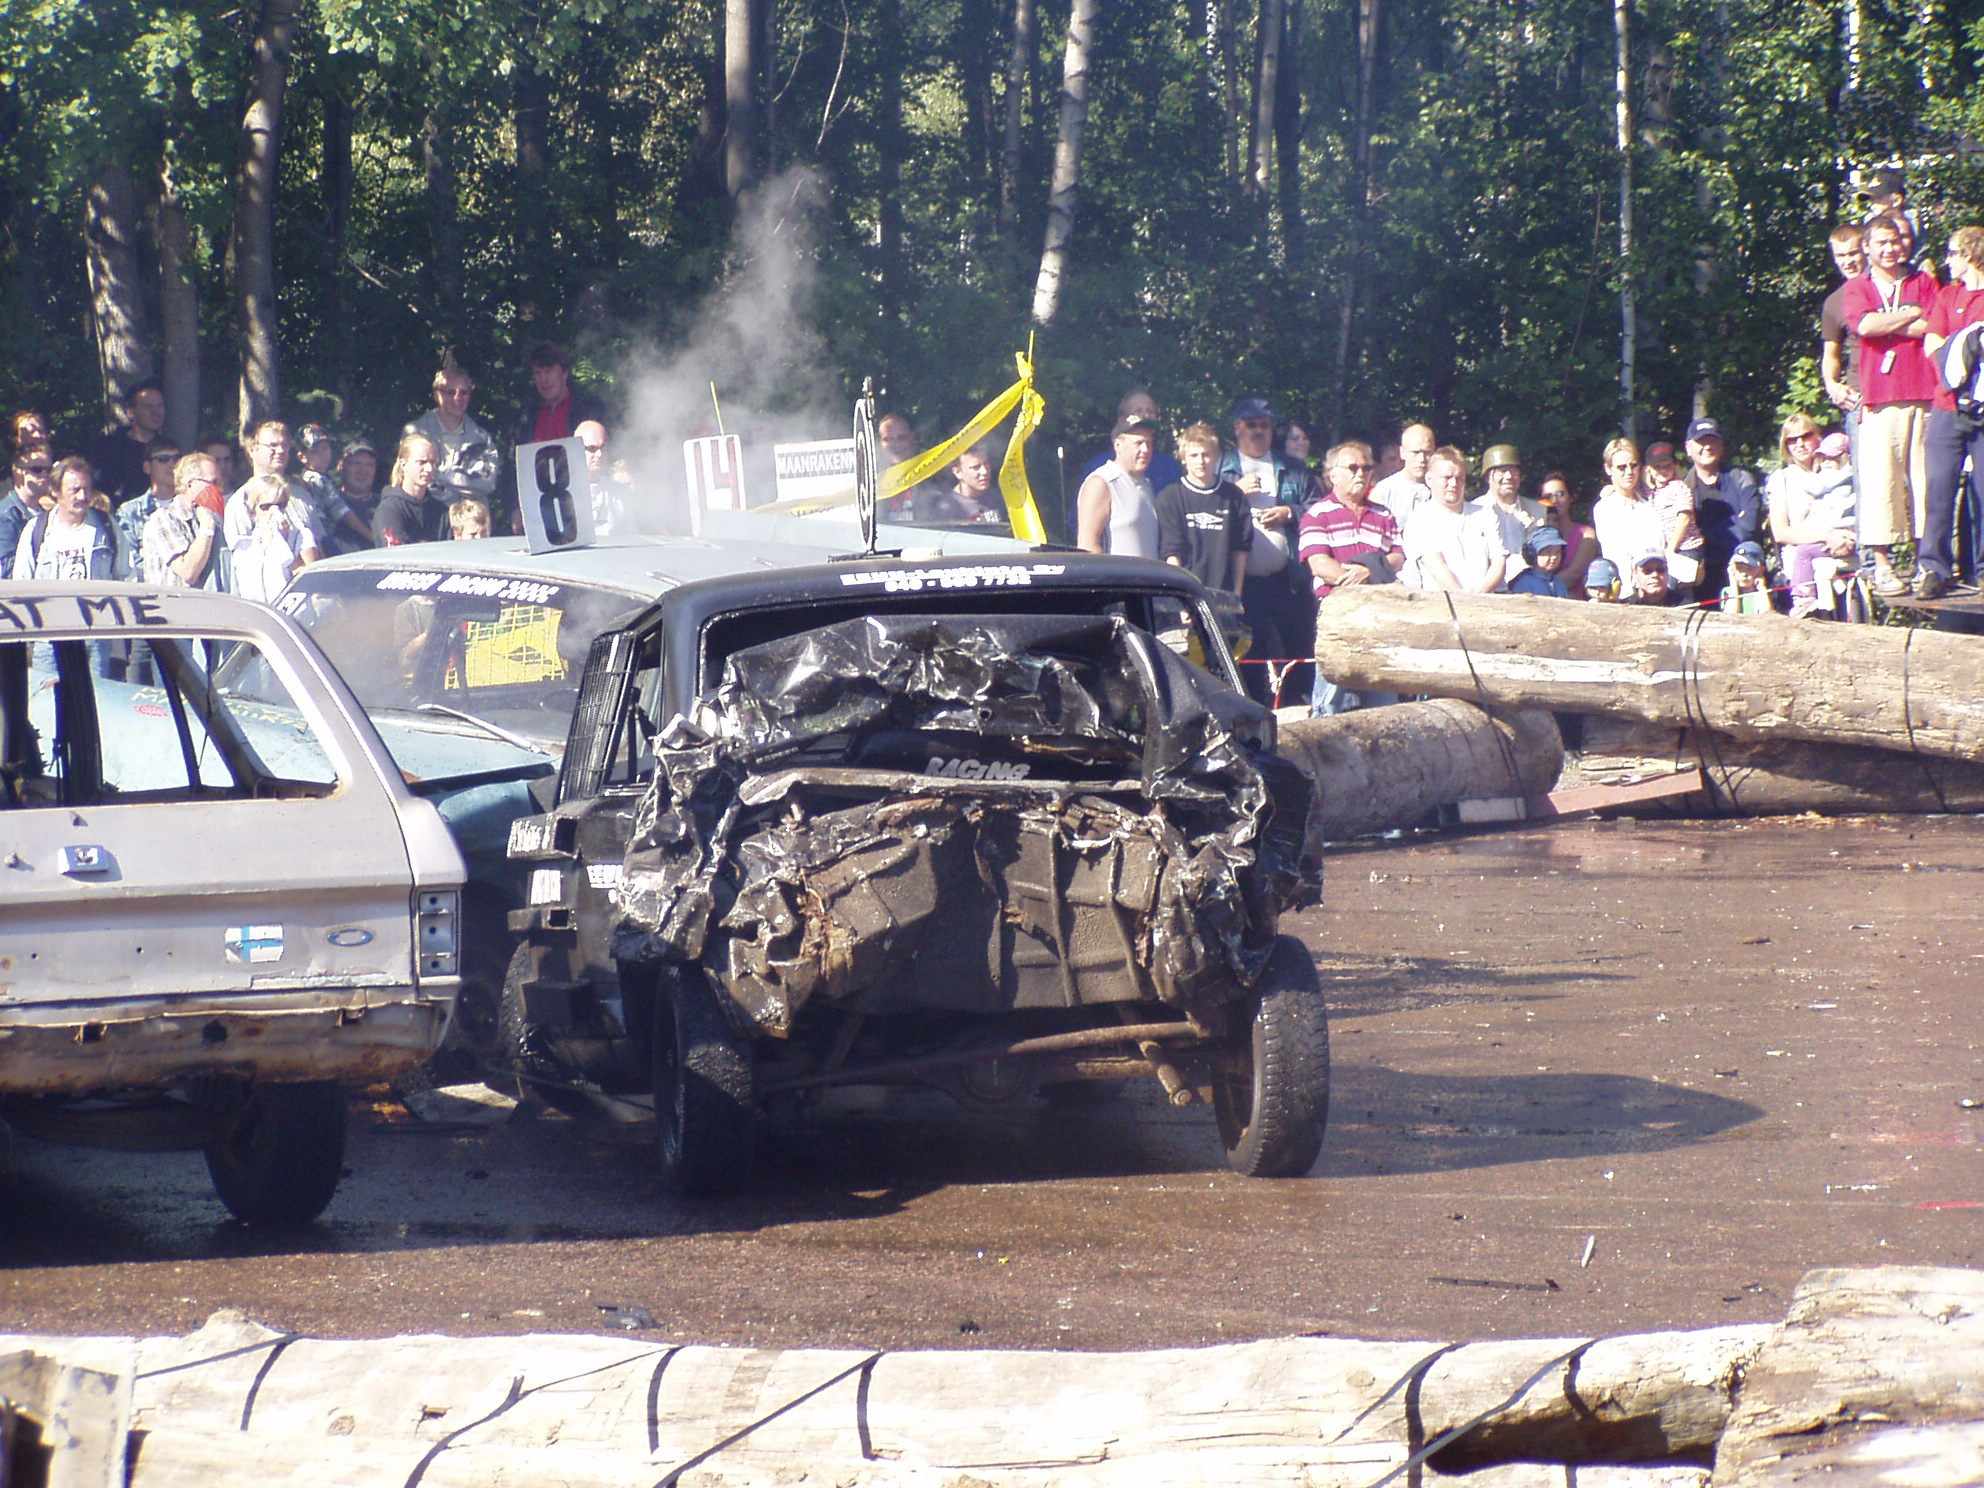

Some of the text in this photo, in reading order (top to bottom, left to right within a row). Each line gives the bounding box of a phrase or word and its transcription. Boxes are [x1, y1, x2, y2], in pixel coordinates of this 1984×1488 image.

[535, 444, 578, 546] 8
[693, 436, 741, 512] 14
[75, 595, 168, 631] ME
